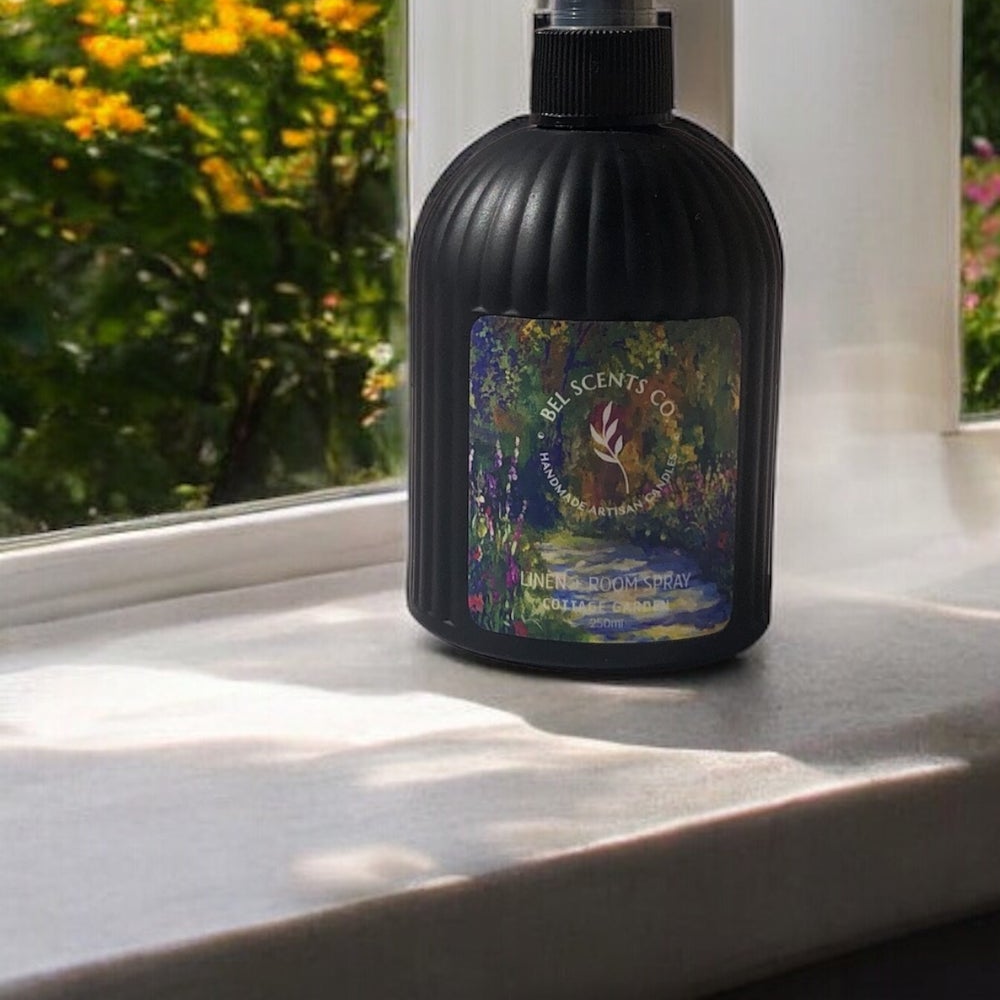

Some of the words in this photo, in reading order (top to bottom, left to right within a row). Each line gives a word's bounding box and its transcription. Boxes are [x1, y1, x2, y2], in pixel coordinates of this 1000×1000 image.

[540, 391, 570, 422] BEL
[570, 372, 648, 396] SCENTS
[539, 452, 588, 511] HANDMADE
[587, 501, 643, 517] ARTISAN
[645, 453, 678, 503] CANDLES
[520, 571, 567, 590] LINEN
[589, 576, 638, 592] ROOM
[644, 573, 691, 591] SPRAY
[543, 598, 605, 613] COTTAGE
[612, 599, 670, 613] GARDEN
